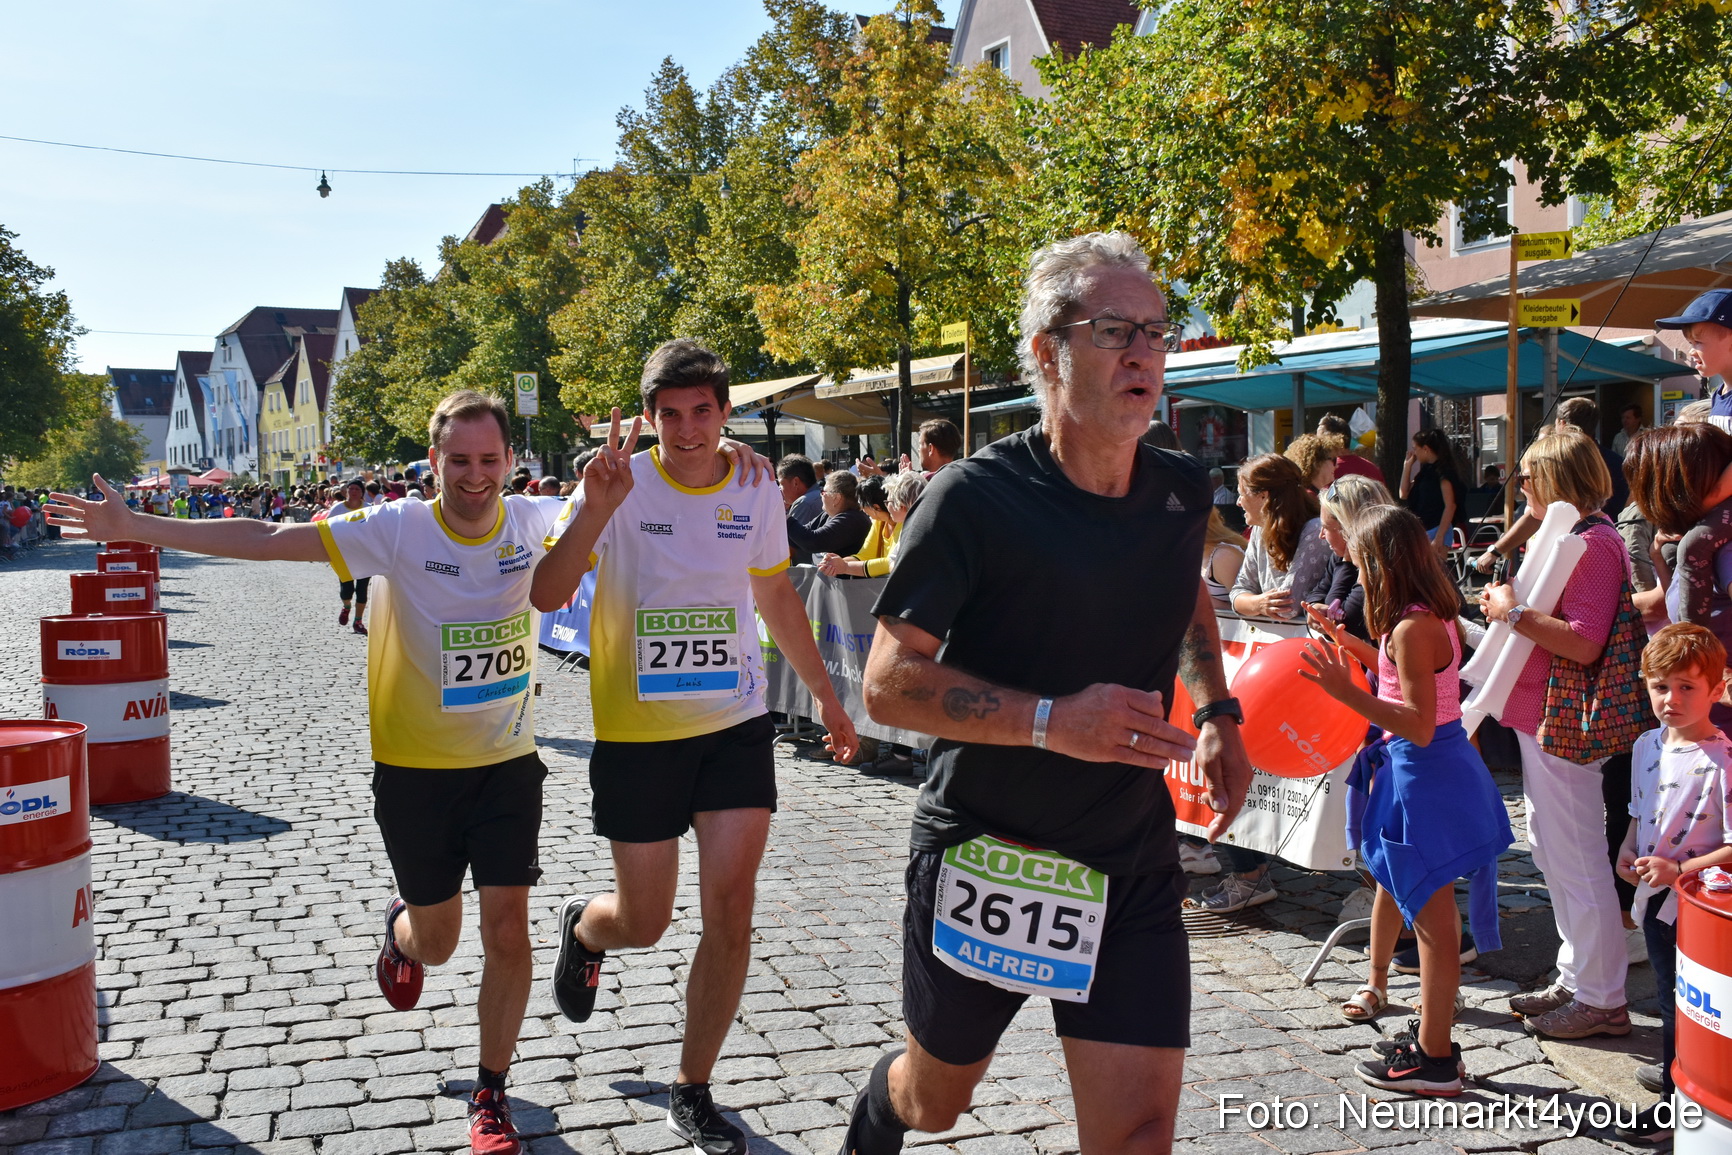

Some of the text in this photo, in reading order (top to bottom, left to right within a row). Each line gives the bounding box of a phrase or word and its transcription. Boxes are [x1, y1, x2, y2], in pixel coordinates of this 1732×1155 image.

[1525, 250, 1552, 259] ausgabe
[1523, 304, 1567, 313] Kleiderbeutel-
[1531, 314, 1558, 324] ausgabe
[945, 329, 966, 340] Toiletten
[718, 508, 733, 521] 20
[717, 532, 747, 540] Stadtlauf
[498, 545, 515, 559] 20
[426, 561, 460, 574] BOCK
[644, 611, 730, 633] BOCK
[449, 616, 526, 648] BOCK
[650, 640, 728, 668] 2755
[455, 644, 525, 682] 2709
[1180, 787, 1195, 803] Sicher
[1258, 784, 1279, 799] 09181
[1287, 789, 1308, 806] 2307-0
[0, 792, 57, 816] ÖDL
[1258, 799, 1279, 814] 09181
[954, 838, 1095, 897] BOCK
[950, 879, 1083, 951] 2615
[1088, 915, 1097, 924] D
[957, 941, 1055, 982] ALFRED
